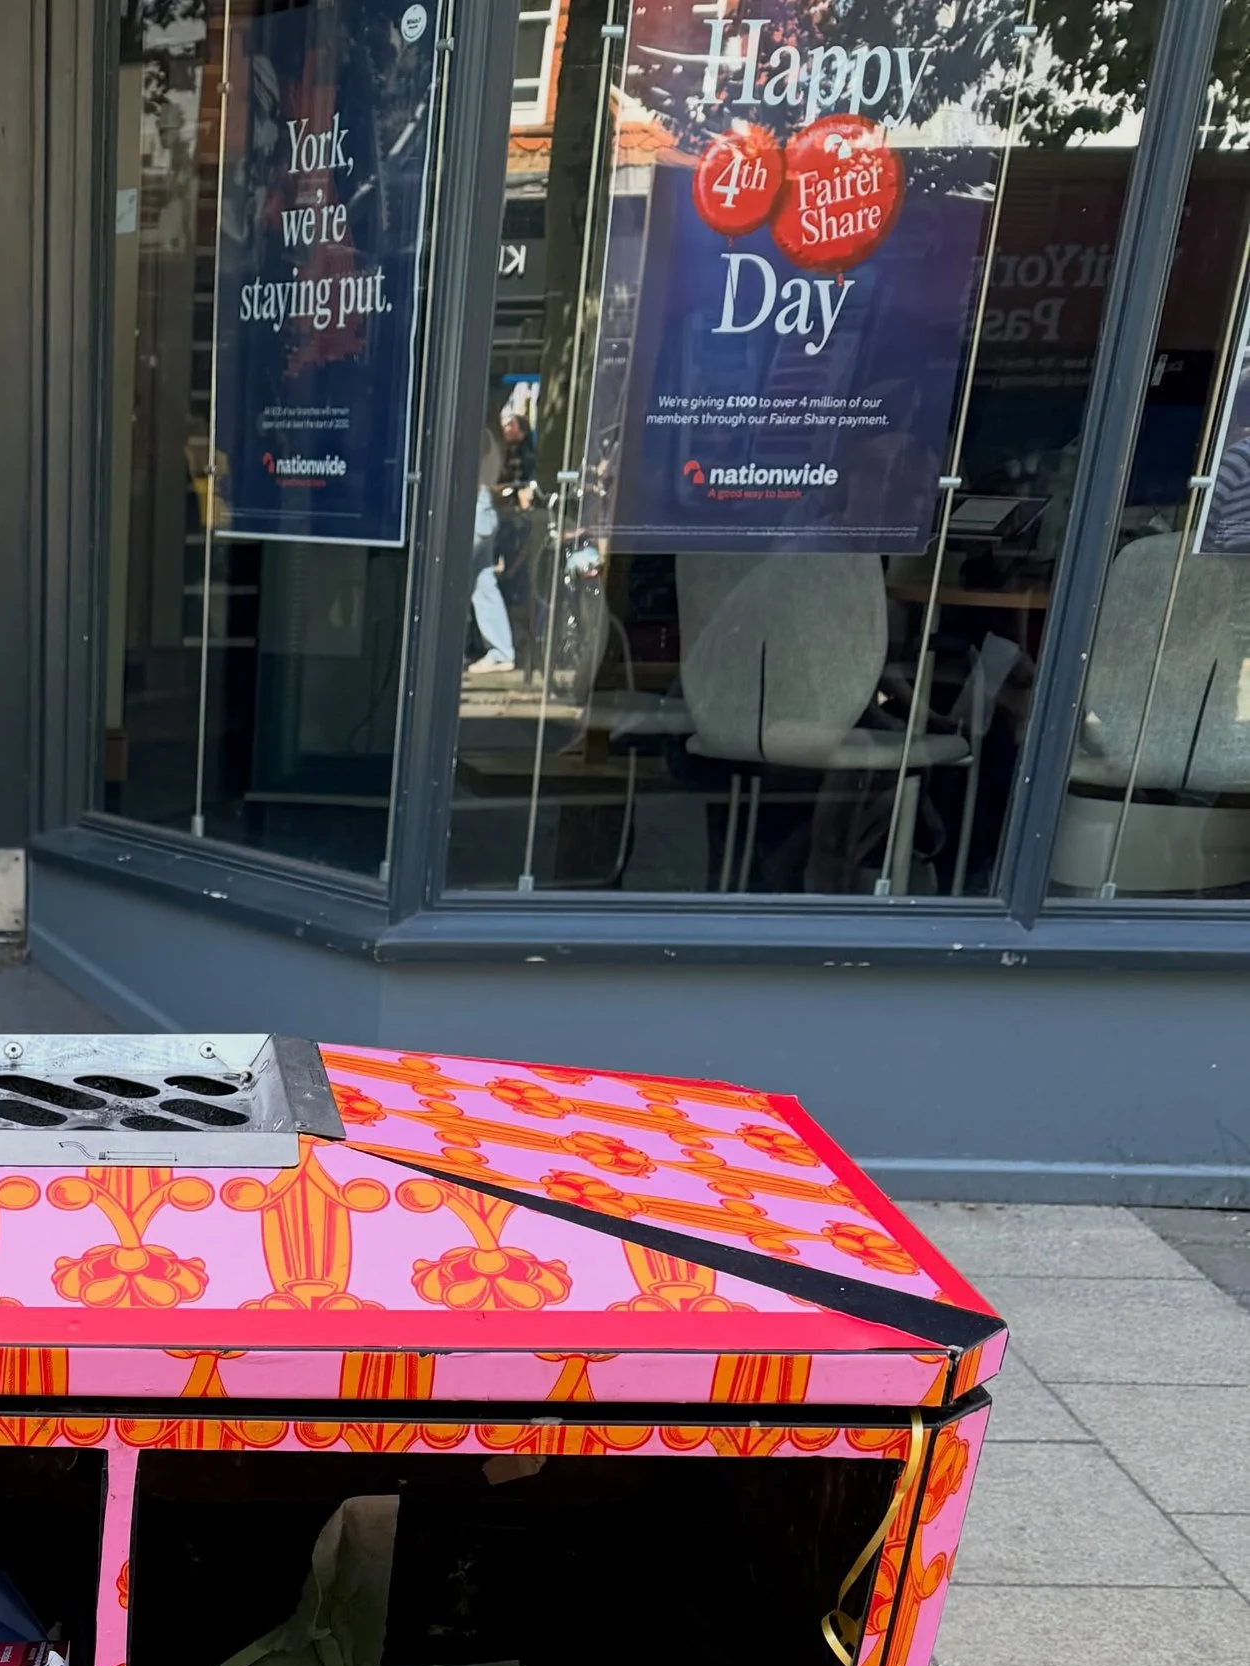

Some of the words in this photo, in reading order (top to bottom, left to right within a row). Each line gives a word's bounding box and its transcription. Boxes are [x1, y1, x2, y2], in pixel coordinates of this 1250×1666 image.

[697, 18, 936, 130] Happy
[286, 112, 354, 176] York,
[712, 152, 768, 209] 4th
[797, 164, 882, 211] Fairer
[281, 188, 348, 248] we're
[800, 203, 882, 246] Share
[240, 267, 333, 333] staying
[337, 265, 393, 328] put.
[710, 252, 856, 356] Day
[646, 414, 700, 425] members
[701, 413, 746, 427] through
[747, 416, 768, 425] our
[769, 413, 802, 425] Fairer
[803, 413, 837, 425] Share
[837, 413, 890, 427] payment.
[658, 395, 689, 408] We're
[690, 396, 725, 410] giving
[726, 396, 757, 408] £100
[758, 397, 771, 408] to
[772, 398, 797, 408] over
[799, 397, 808, 408] 4
[809, 396, 847, 409] million
[848, 396, 861, 409] of
[862, 398, 883, 409] our
[276, 454, 347, 476] nationwide
[709, 463, 838, 486] nationwide
